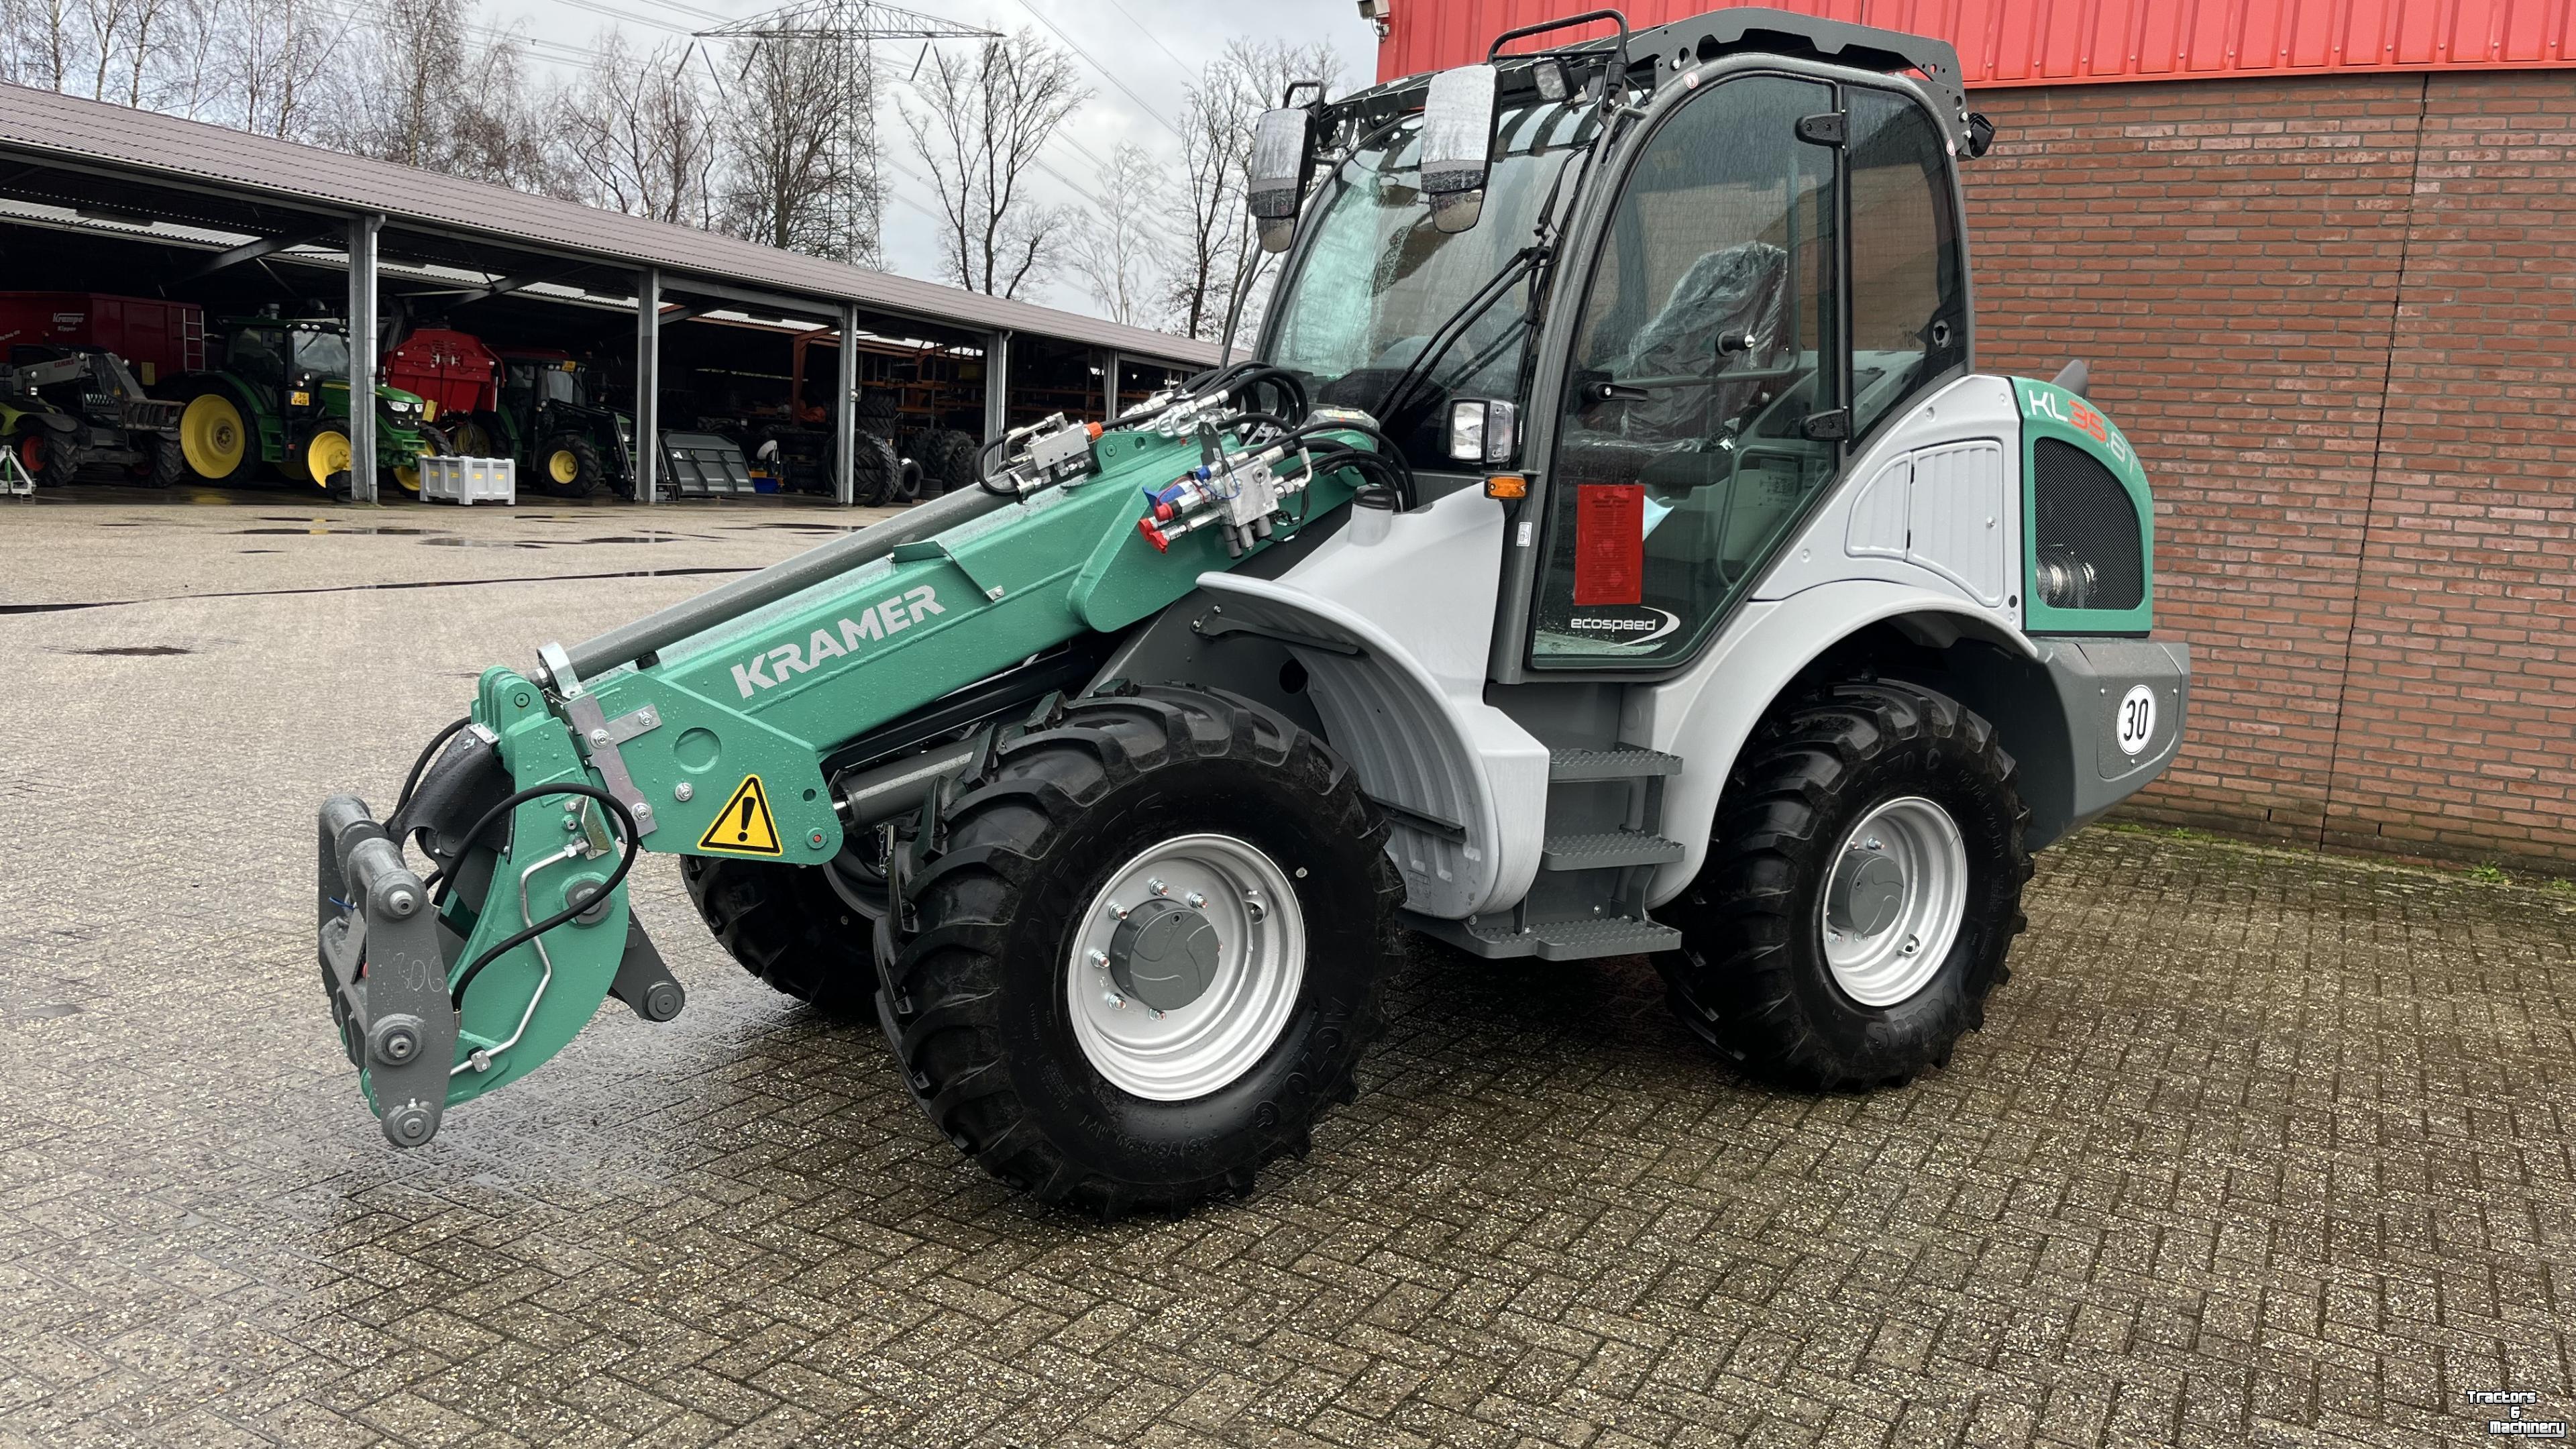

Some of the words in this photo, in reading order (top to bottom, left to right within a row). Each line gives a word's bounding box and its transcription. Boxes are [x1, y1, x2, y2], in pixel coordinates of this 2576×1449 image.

[730, 585, 947, 699] KRAMER
[1570, 618, 1656, 633] ecospeed
[2123, 698, 2149, 741] 30
